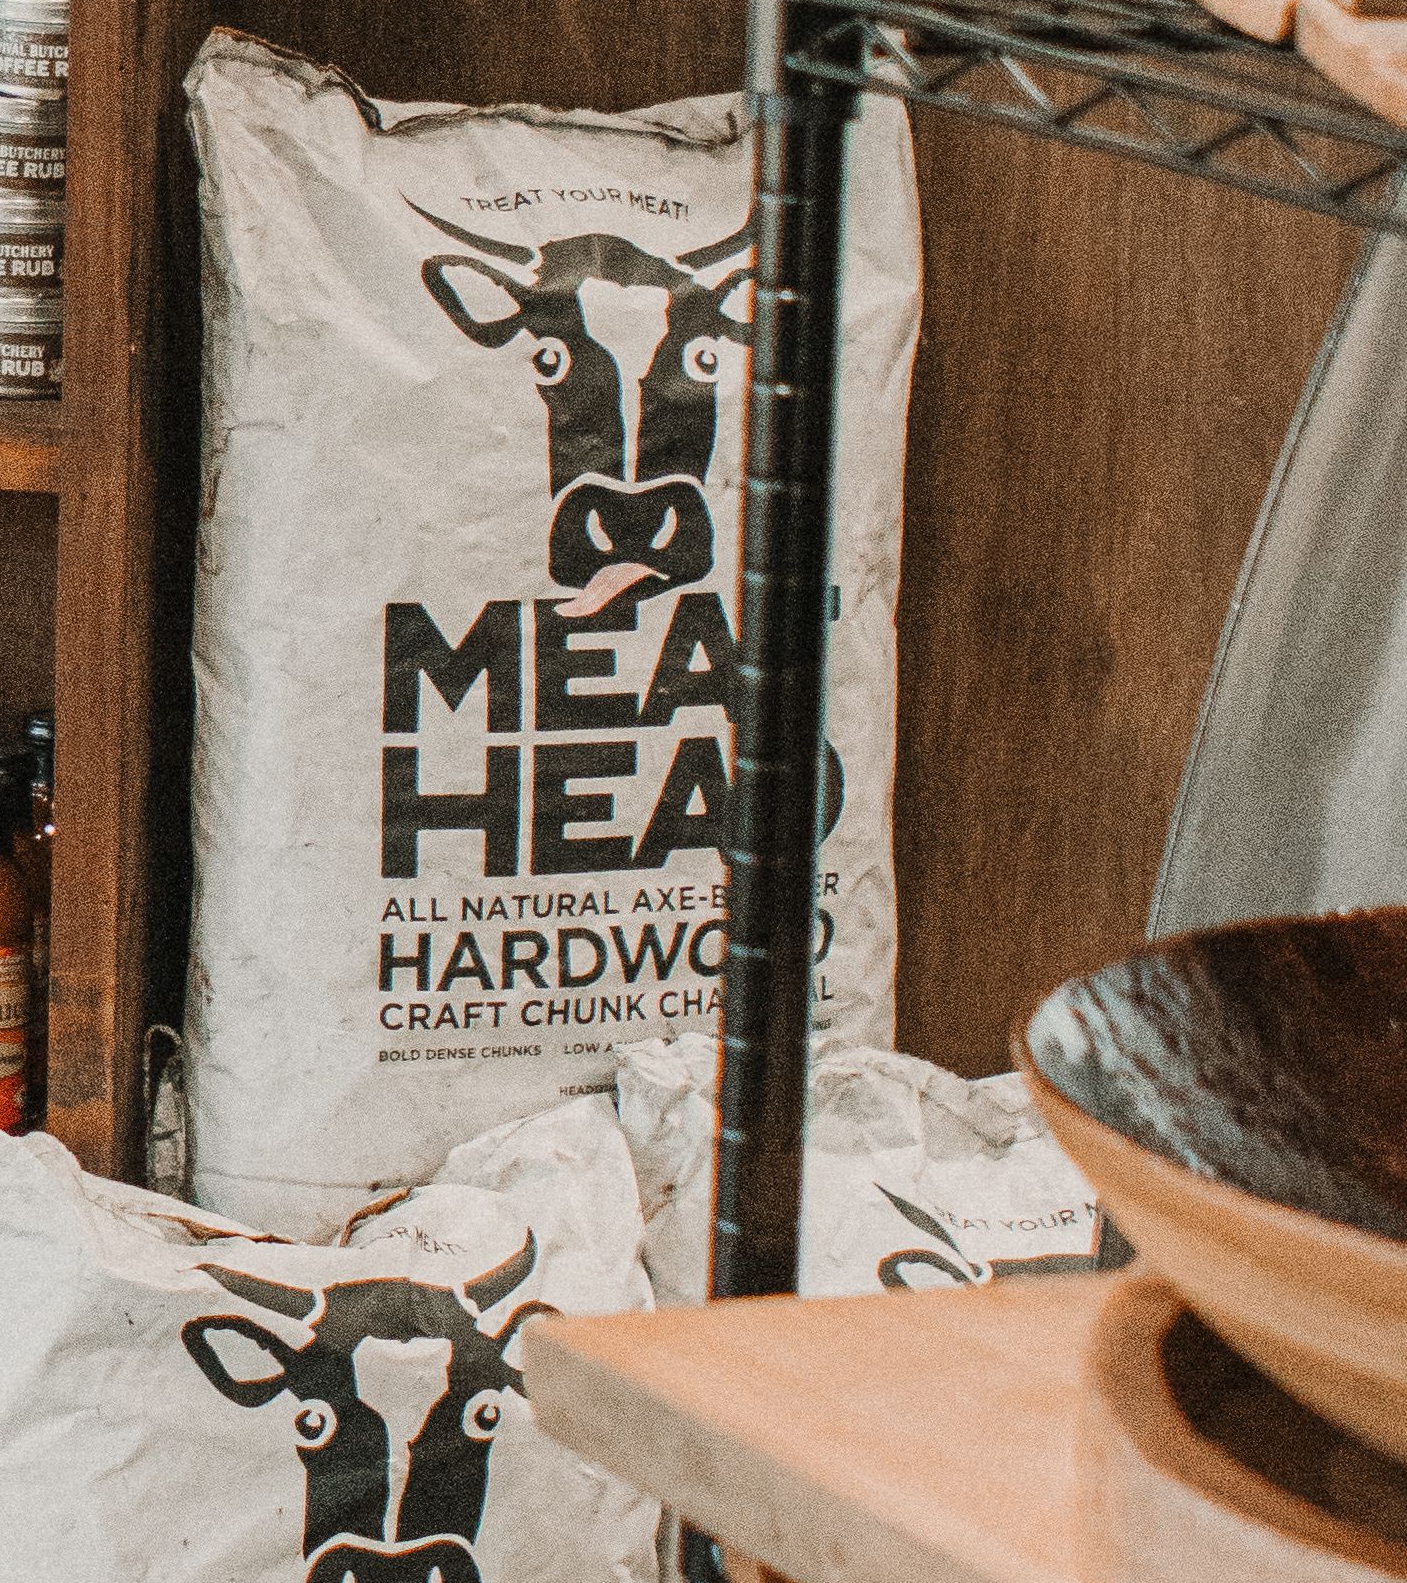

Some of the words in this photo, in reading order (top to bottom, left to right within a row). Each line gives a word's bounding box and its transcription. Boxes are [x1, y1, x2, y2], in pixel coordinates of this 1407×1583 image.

[460, 188, 544, 212] TREAT
[554, 187, 623, 205] YOUR
[626, 188, 691, 223] MEAT!
[13, 259, 55, 277] RUB
[383, 590, 839, 734] MEA
[380, 895, 448, 922] ALL
[460, 890, 619, 921] NATURAL
[630, 871, 840, 915] AXE-BER
[376, 907, 836, 992] HARDWO
[377, 1001, 508, 1030] CRAFT
[519, 992, 647, 1027] CHUNK
[376, 1048, 421, 1063] BOLD
[424, 1046, 475, 1061] DENSE
[480, 1044, 542, 1059] CHUNKS
[563, 1042, 601, 1056] LOW
[998, 1208, 1079, 1233] YOUR
